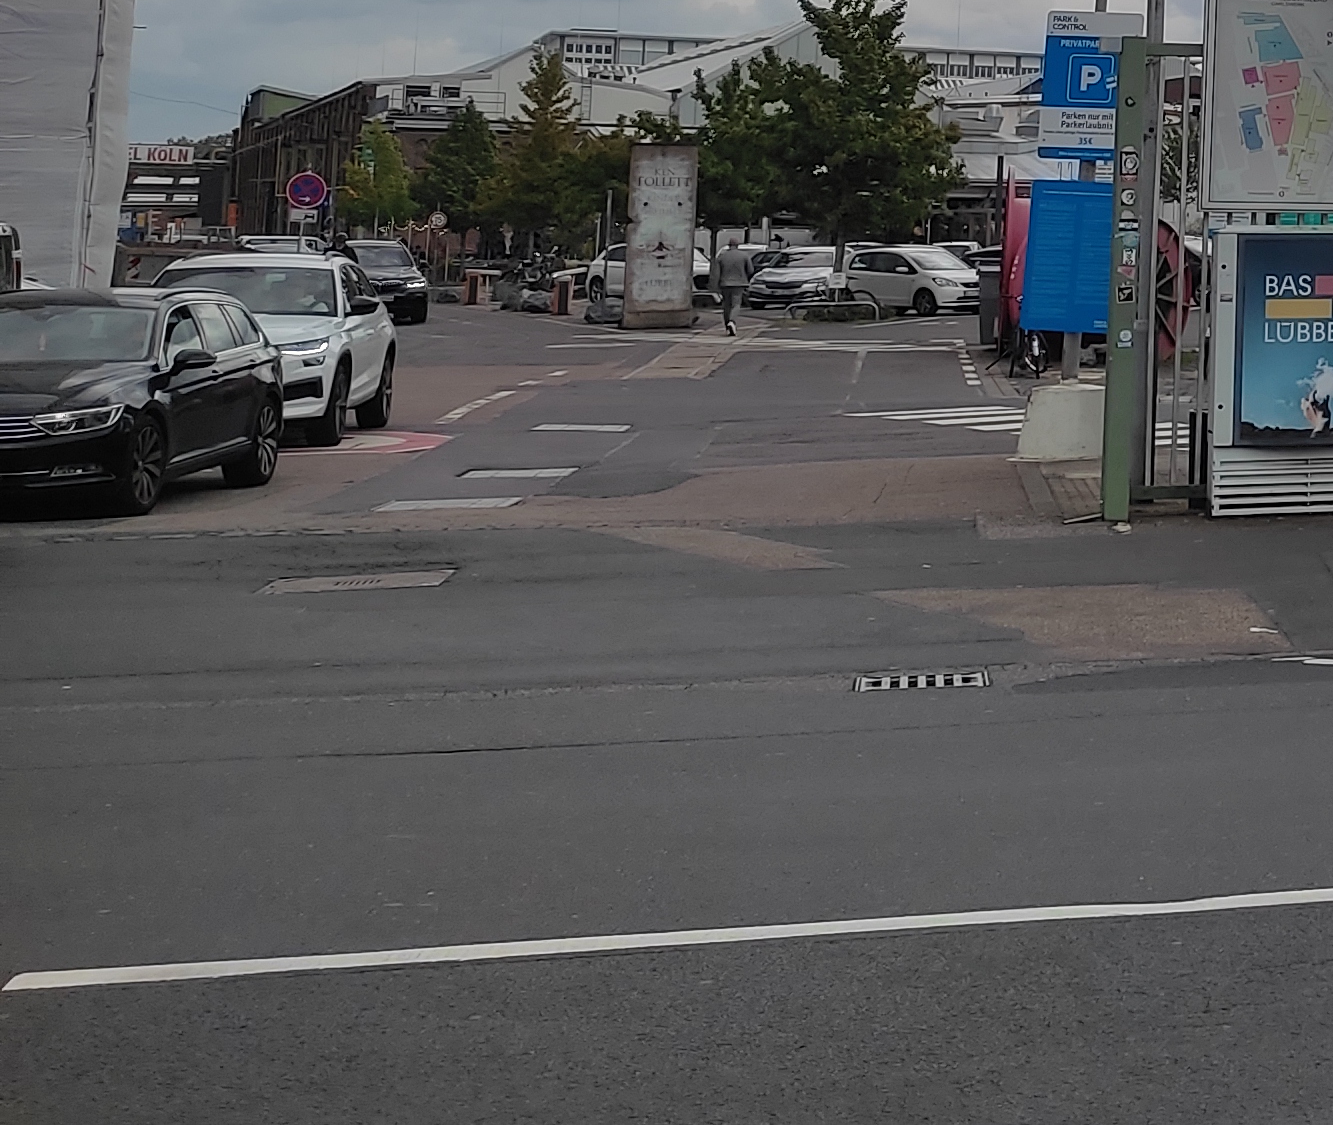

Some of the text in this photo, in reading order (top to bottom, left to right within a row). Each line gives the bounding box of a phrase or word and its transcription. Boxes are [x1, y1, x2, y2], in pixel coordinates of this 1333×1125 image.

[1079, 64, 1102, 92] P
[1061, 111, 1086, 121] Parken
[1087, 113, 1100, 121] nur
[1060, 120, 1114, 130] Parkerlaubnis
[1265, 274, 1313, 296] BAS
